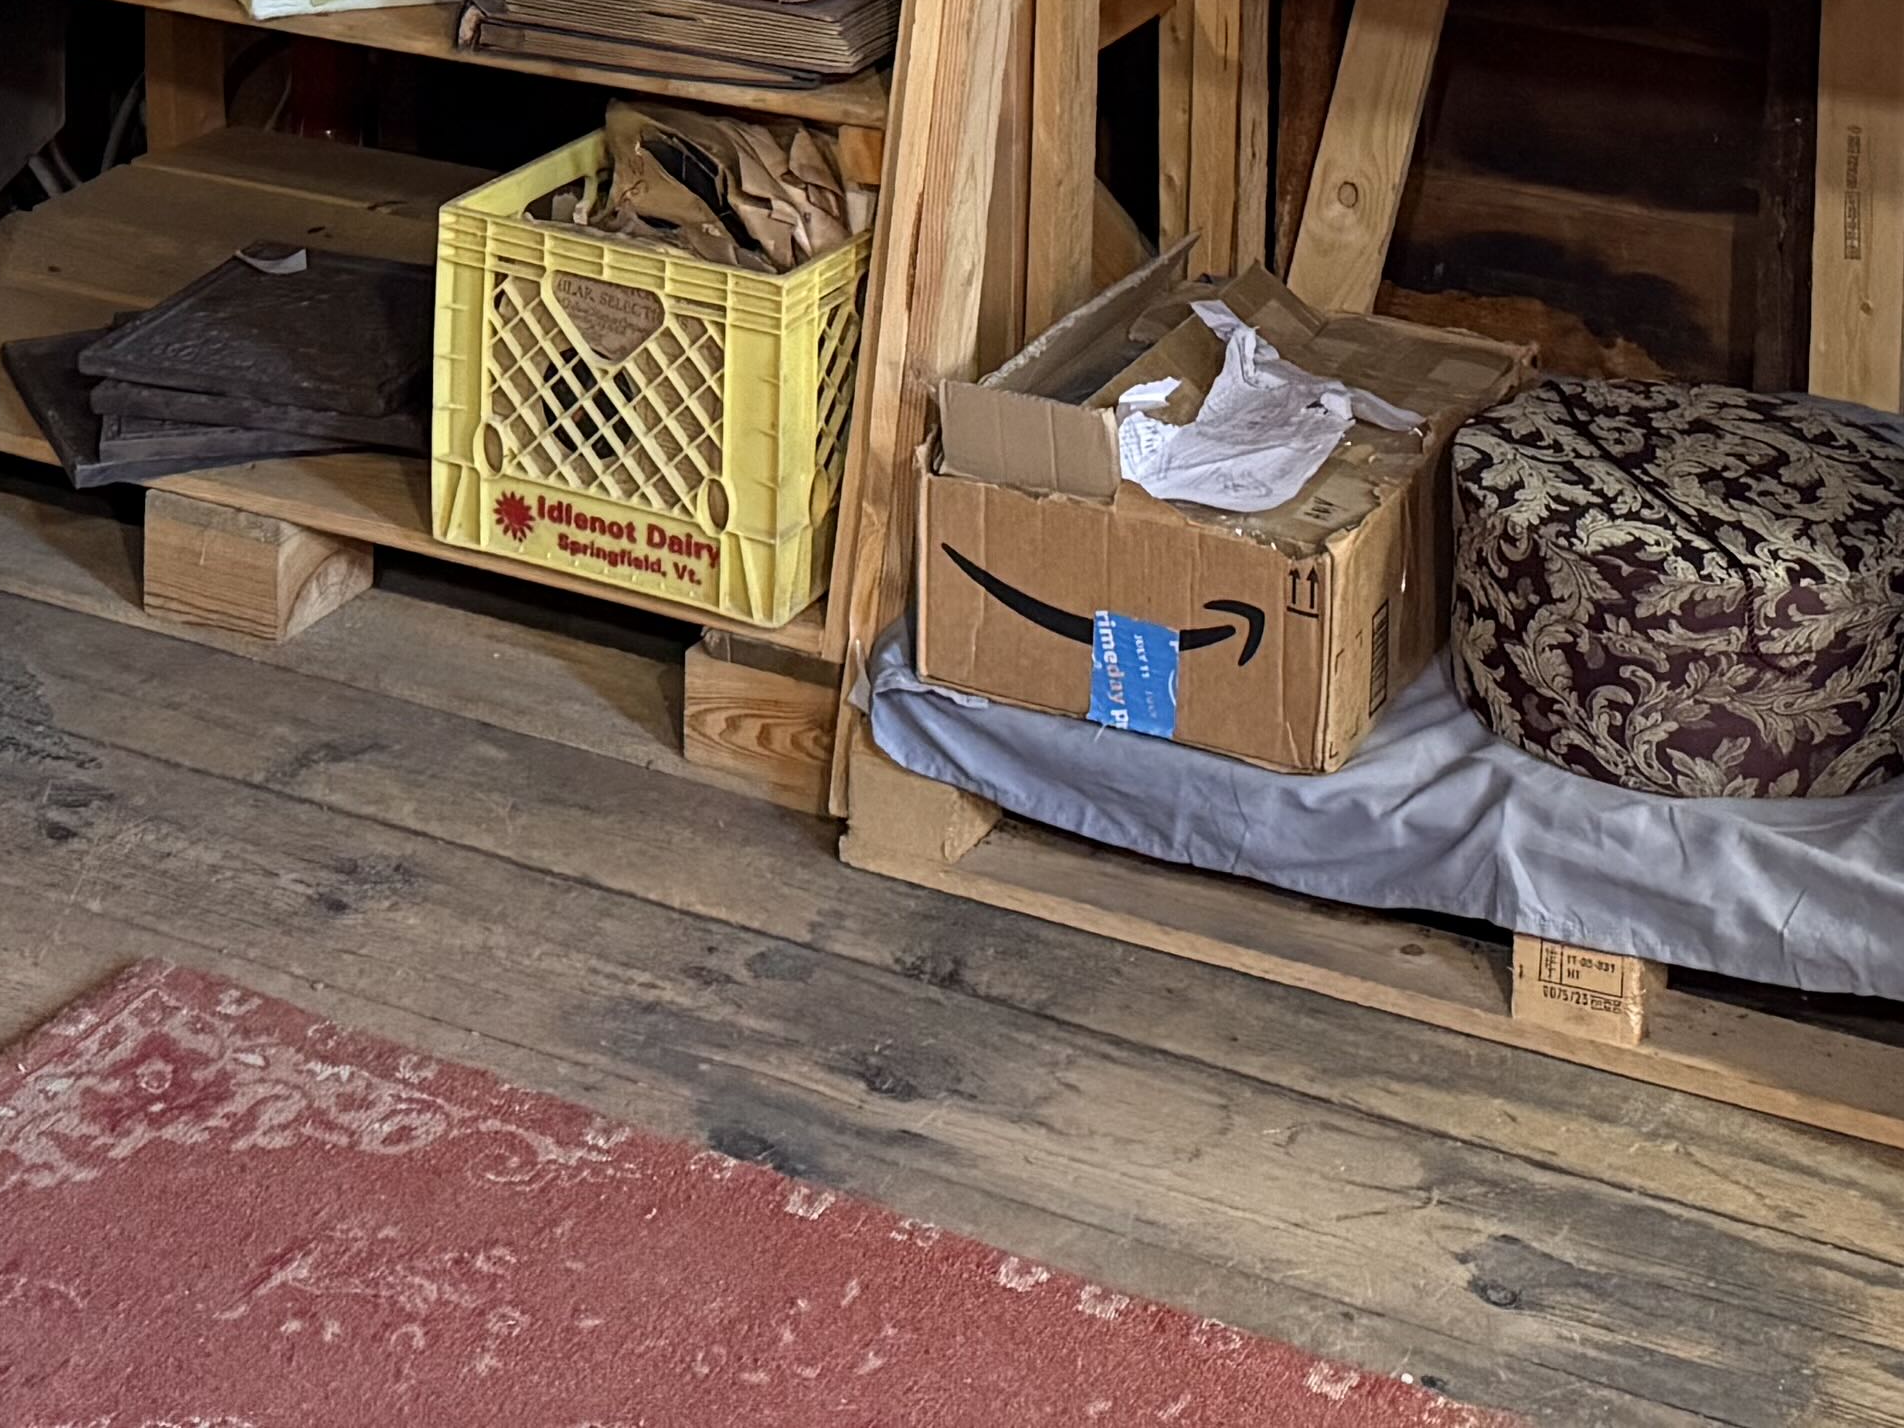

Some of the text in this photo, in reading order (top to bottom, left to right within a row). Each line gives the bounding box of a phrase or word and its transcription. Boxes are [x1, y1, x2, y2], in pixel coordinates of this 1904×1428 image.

[537, 495, 720, 568] Idlenot Dairy
[558, 533, 701, 585] Springfield, Vt.
[1134, 635, 1149, 662] JULY
